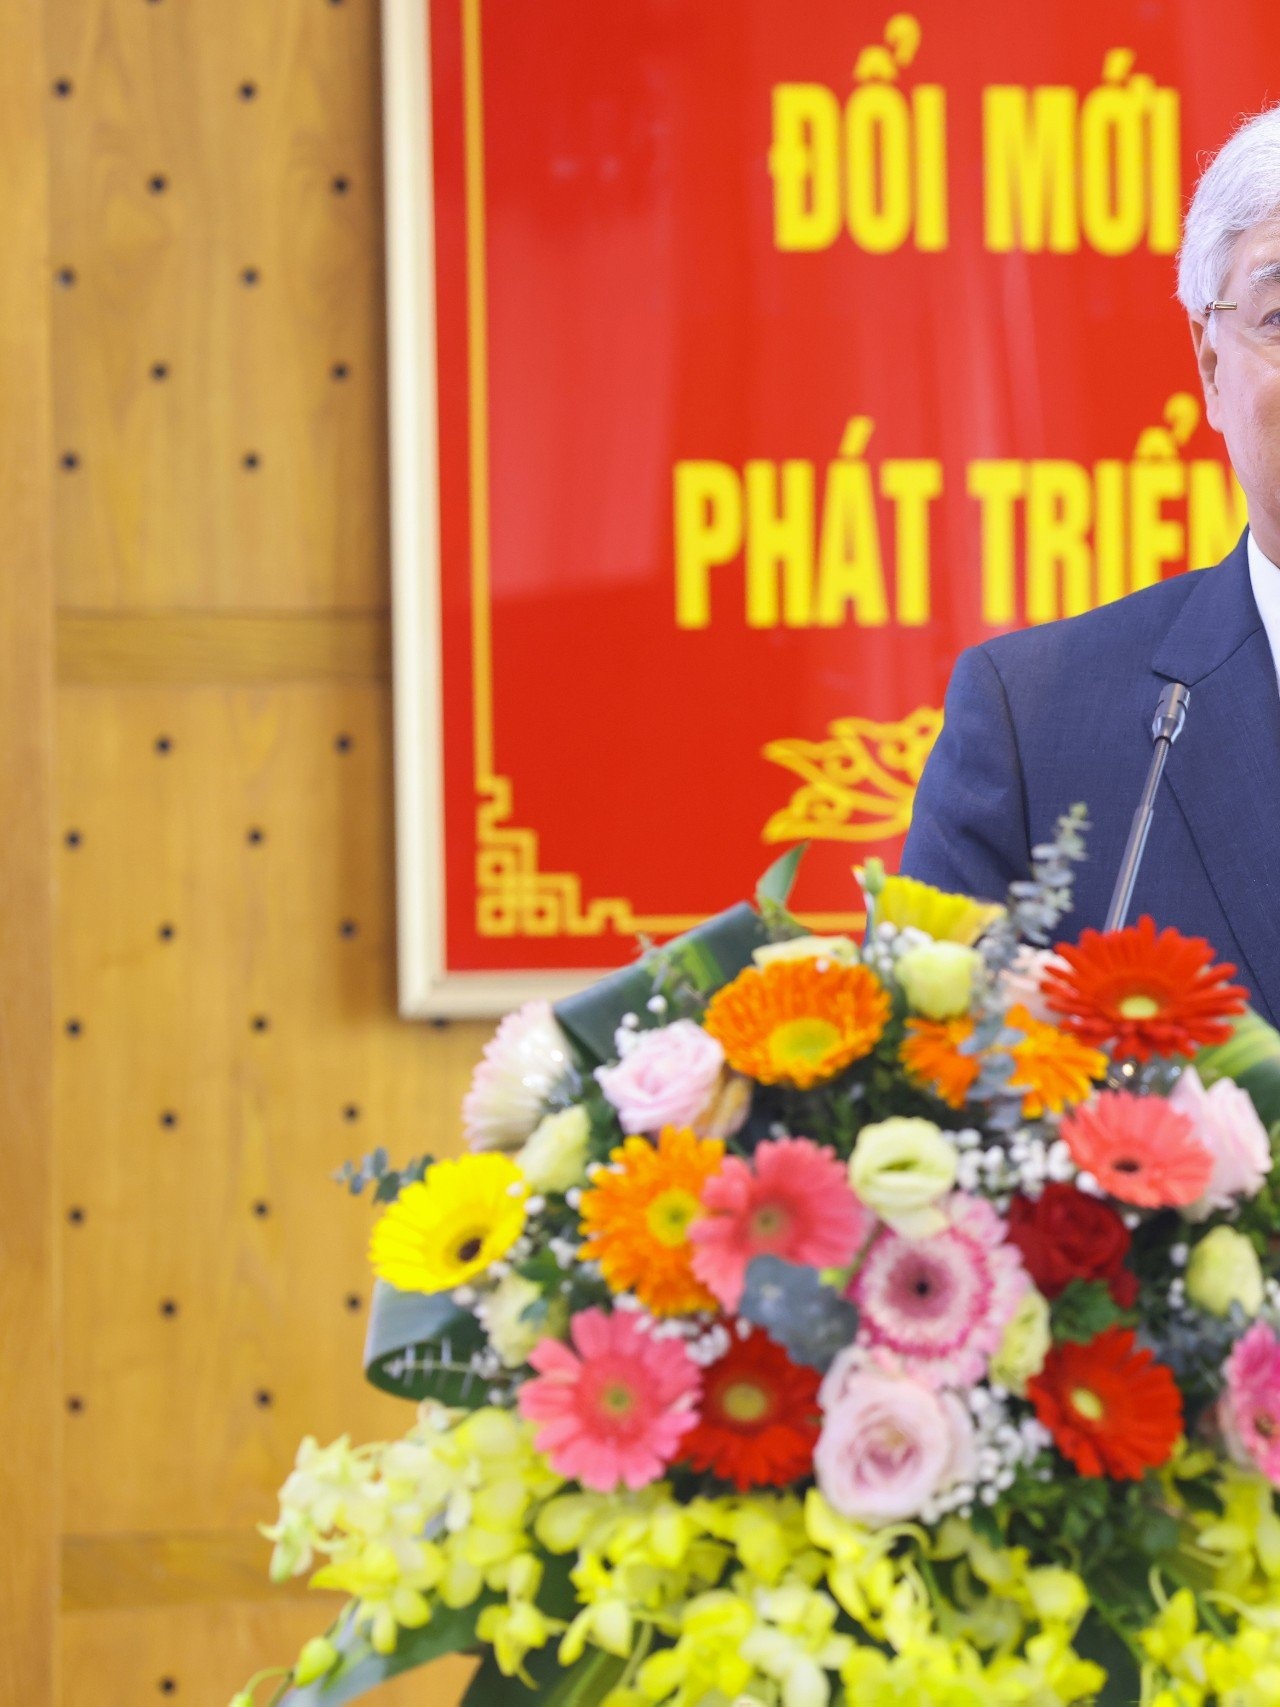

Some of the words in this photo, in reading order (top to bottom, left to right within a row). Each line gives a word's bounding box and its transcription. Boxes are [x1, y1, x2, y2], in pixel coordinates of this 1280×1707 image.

[768, 13, 948, 253] ĐỔI
[982, 47, 1181, 255] MỚI
[673, 415, 942, 629] PHÁT
